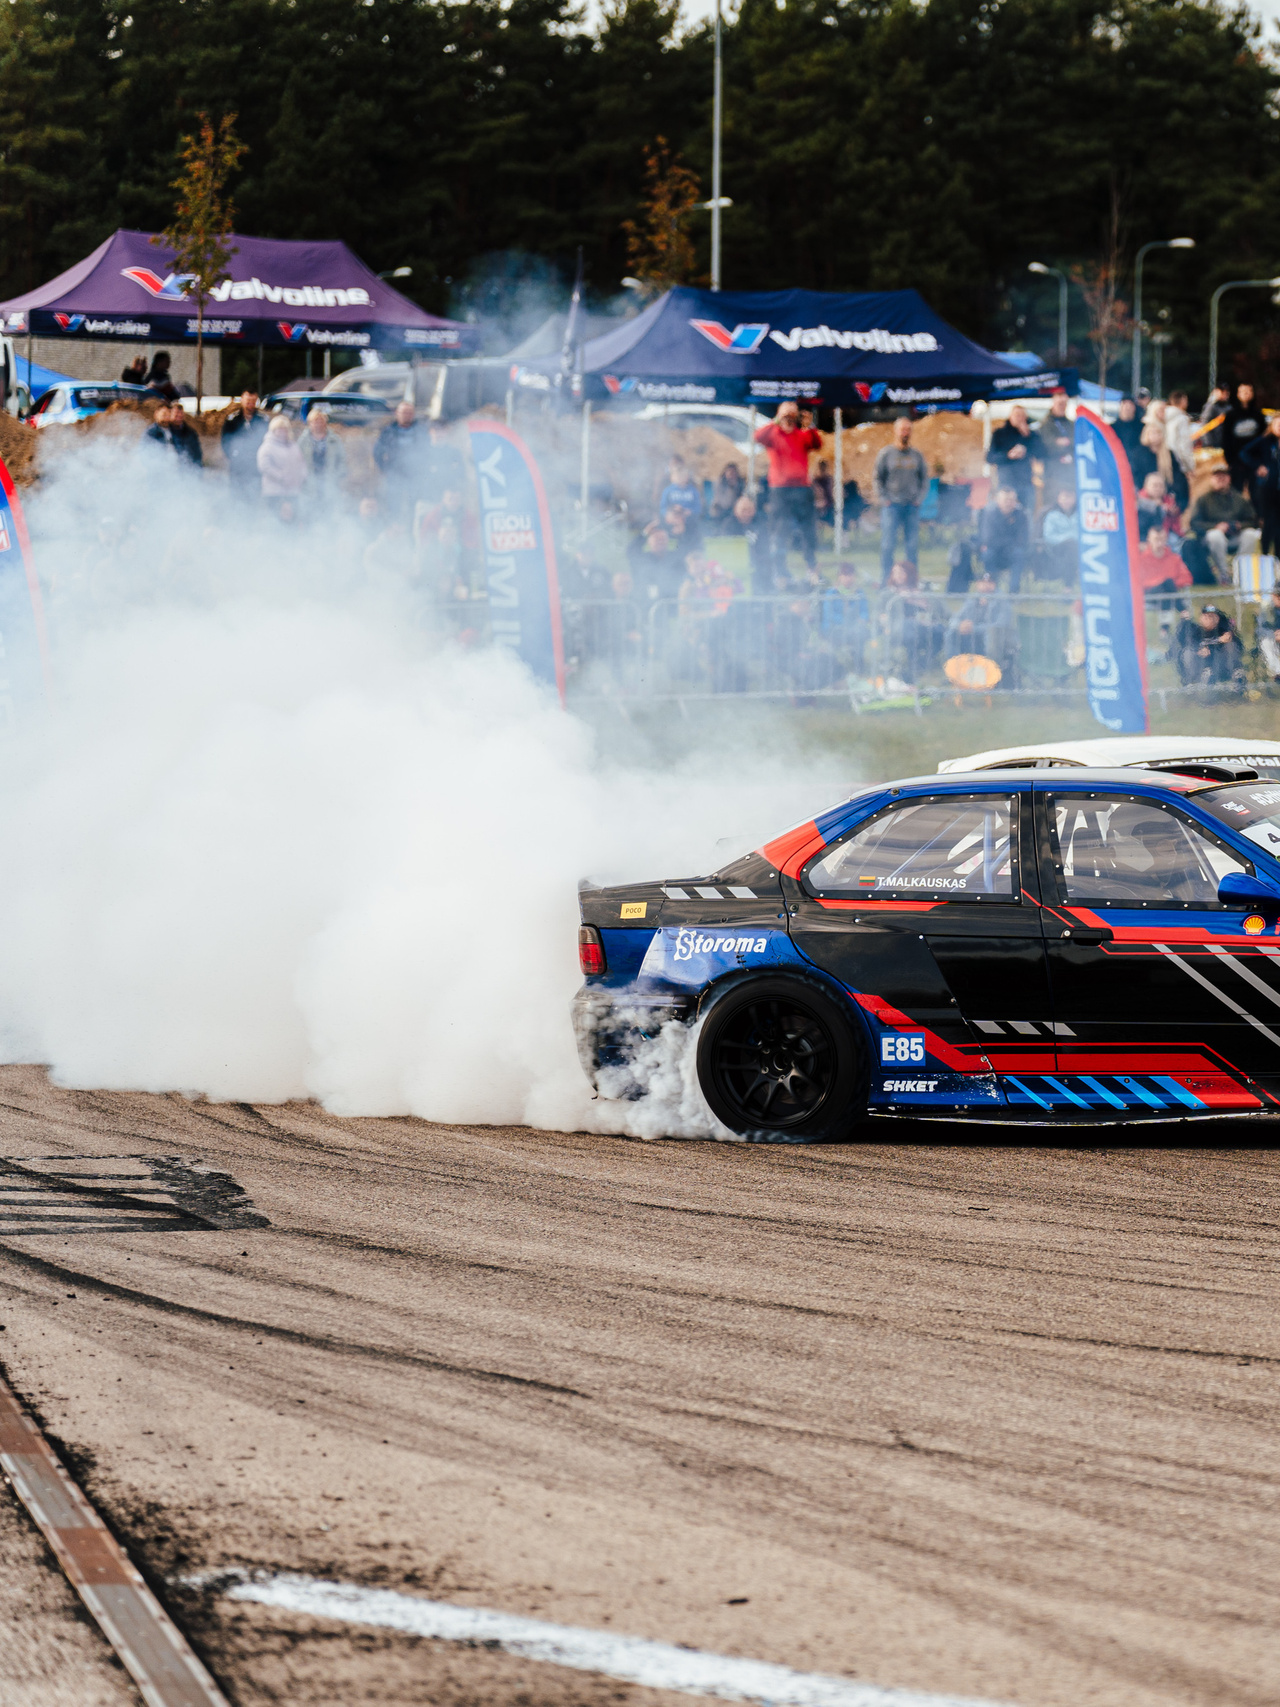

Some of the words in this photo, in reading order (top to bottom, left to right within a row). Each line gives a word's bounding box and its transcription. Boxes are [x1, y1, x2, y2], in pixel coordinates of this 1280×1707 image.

[208, 277, 370, 307] Valvoline
[769, 325, 937, 354] Valvoline
[877, 876, 967, 889] T.MALKAUSKAS
[673, 927, 768, 962] Storoma
[881, 1037, 924, 1062] E85
[883, 1080, 939, 1093] SHKET
